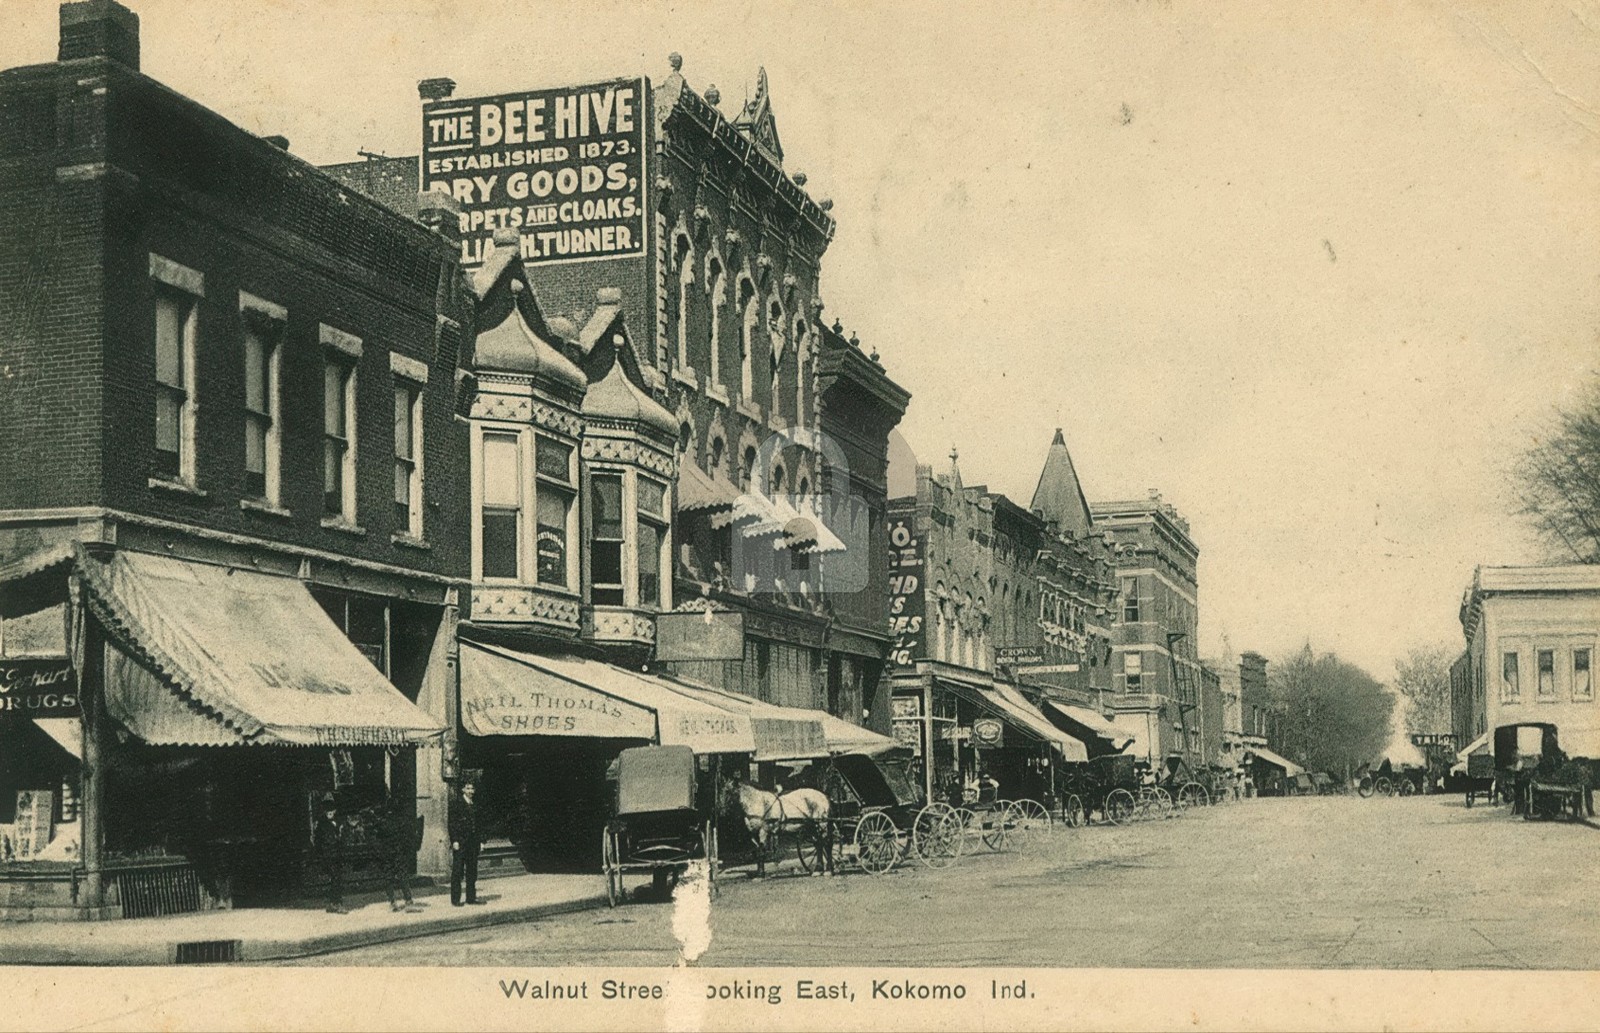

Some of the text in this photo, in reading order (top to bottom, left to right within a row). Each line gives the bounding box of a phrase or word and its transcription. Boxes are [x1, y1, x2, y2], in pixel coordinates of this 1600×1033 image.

[428, 88, 635, 147] THE BEE HIVE
[428, 139, 637, 175] ESTABLISHED 1873.
[506, 161, 638, 200] GOODS,
[459, 206, 524, 234] RPETS
[525, 205, 559, 225] AND
[1000, 647, 1037, 657] CROWN
[466, 692, 624, 719] NEIL THOMAS
[501, 715, 577, 732] SHOES
